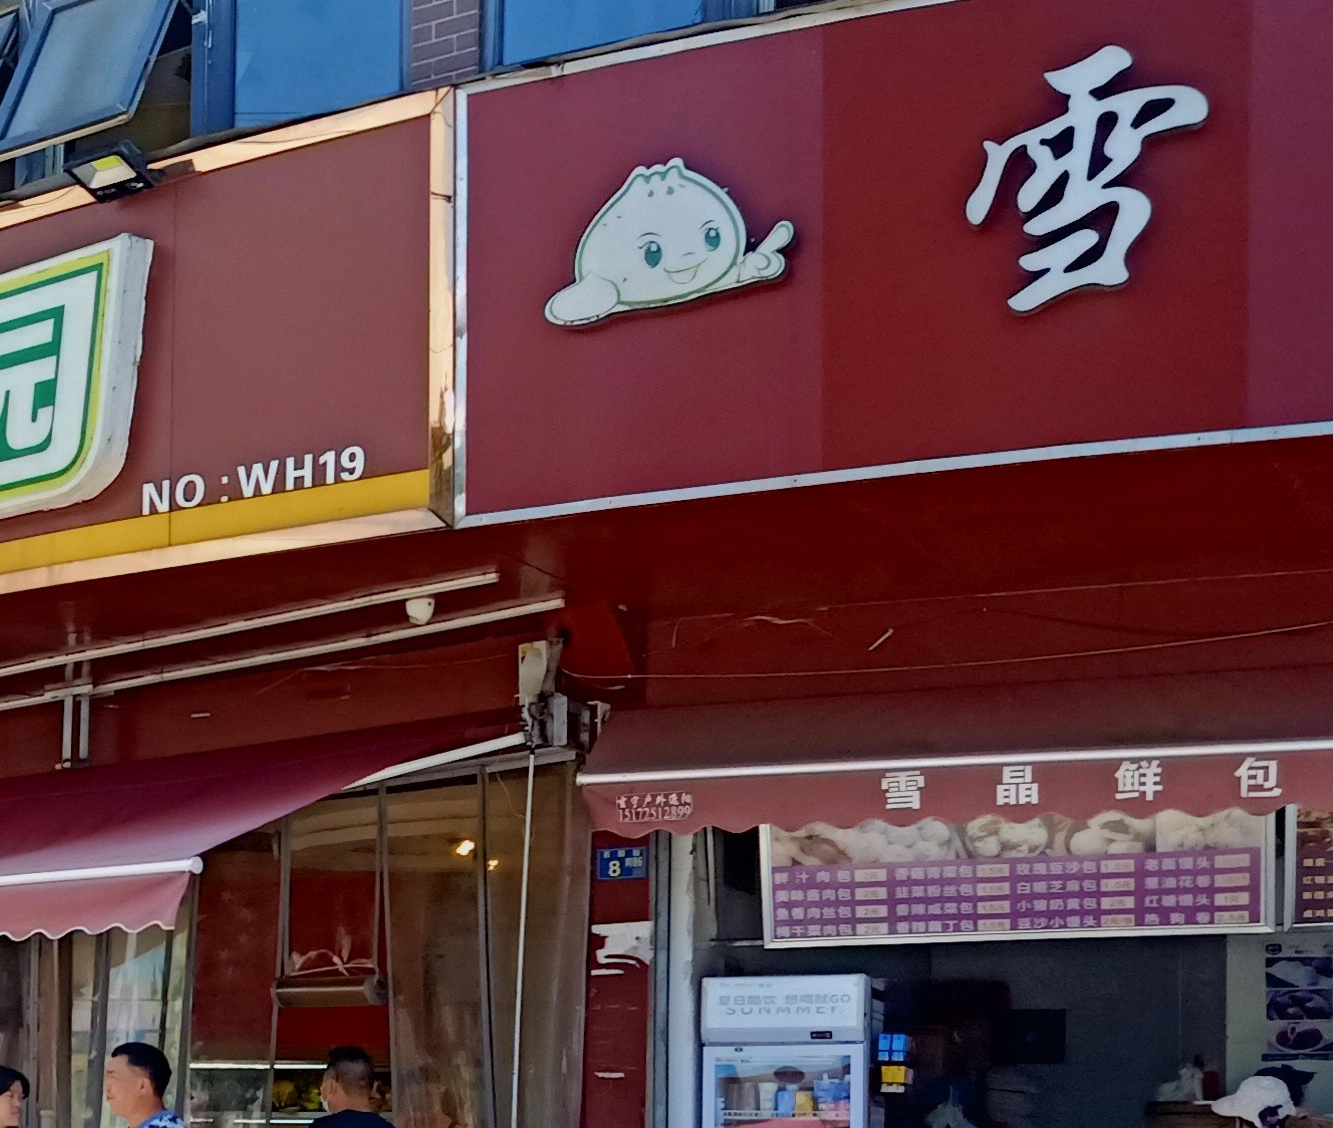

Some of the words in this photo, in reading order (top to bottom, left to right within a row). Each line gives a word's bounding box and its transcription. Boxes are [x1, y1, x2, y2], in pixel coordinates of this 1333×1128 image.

[964, 44, 1210, 316] 雪
[881, 757, 1283, 810] 雪晶鲜包
[618, 805, 692, 822] 15172512899
[608, 860, 622, 878] 8
